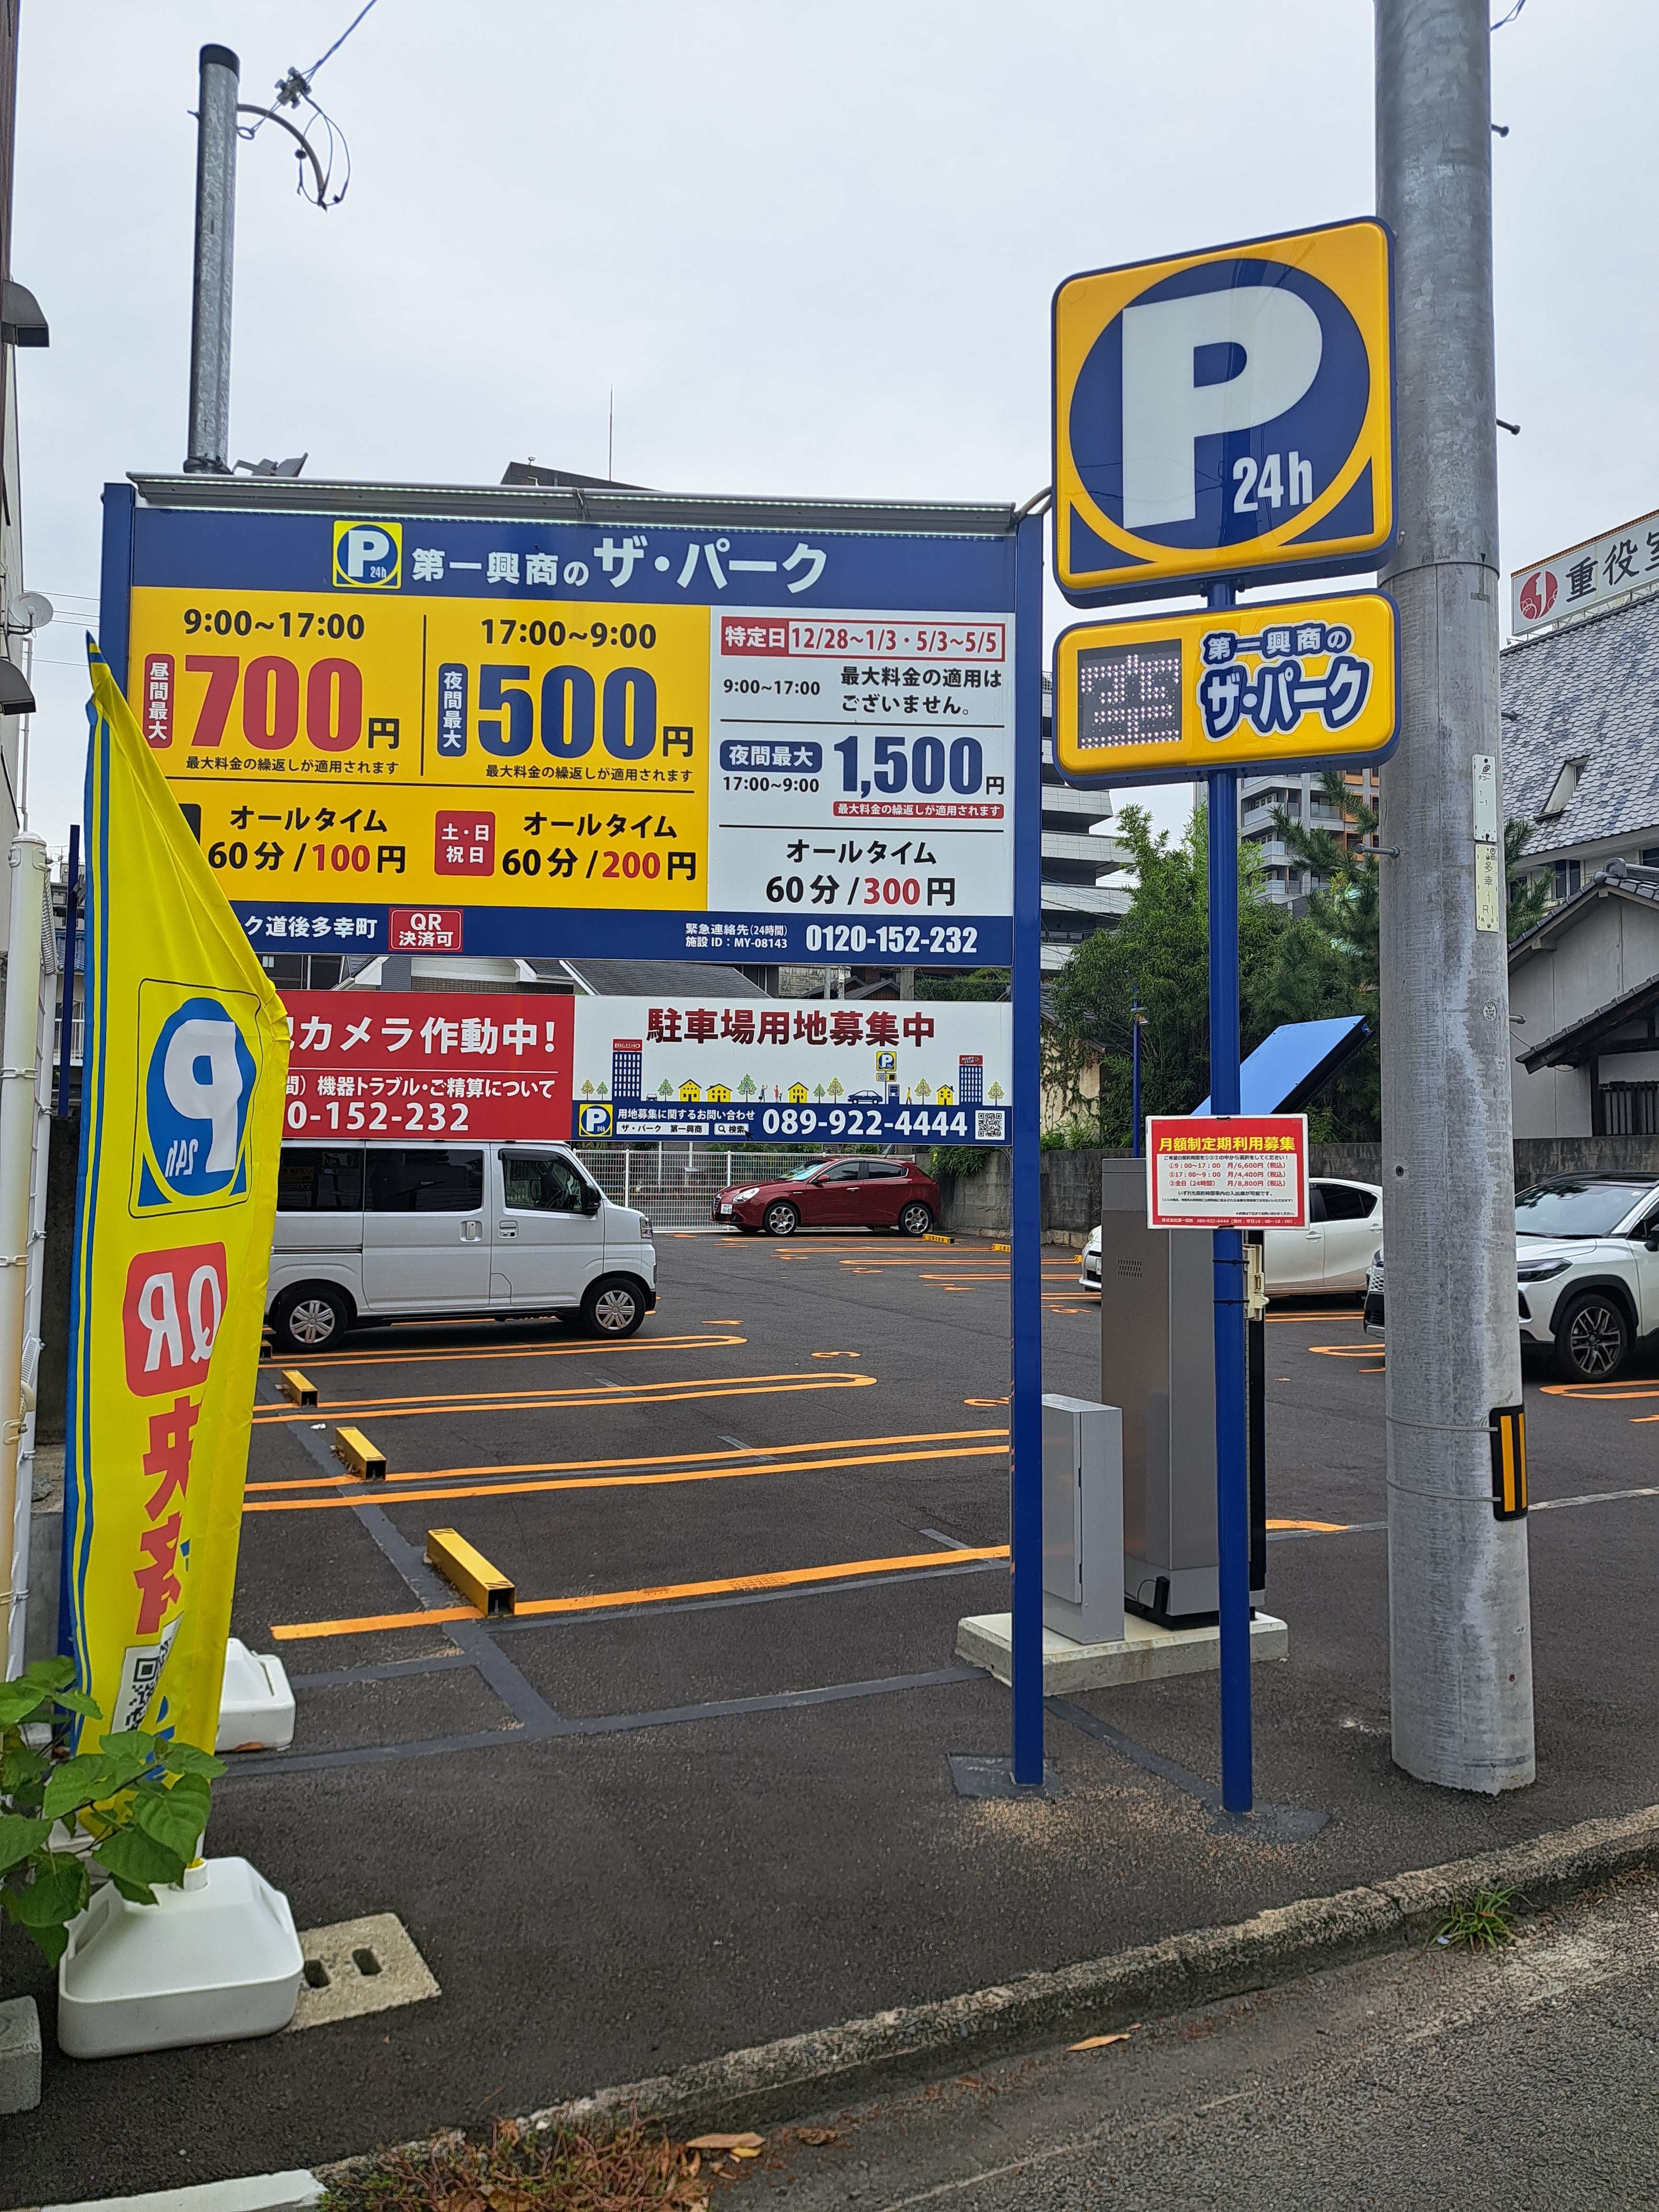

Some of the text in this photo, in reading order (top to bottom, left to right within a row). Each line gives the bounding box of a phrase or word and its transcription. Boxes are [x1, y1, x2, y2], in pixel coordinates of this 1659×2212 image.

[1122, 286, 1323, 530] P
[1233, 450, 1313, 514] 24h
[348, 530, 389, 577] P
[411, 535, 827, 594] 第一興商のザ・パーク
[370, 566, 387, 578] 24h
[725, 627, 785, 649] 特定日
[1208, 627, 1348, 661] 第一興商の
[841, 665, 1002, 689] 最大料金の適用は
[148, 662, 169, 741] 昼間最大
[841, 694, 969, 716] ございません。
[1207, 663, 1363, 732] ザ・パーク
[443, 671, 463, 749] 夜間最大
[186, 755, 399, 775] 最大料金の繰返しが適用されます
[729, 745, 814, 767] 夜間最大
[486, 764, 693, 783] 最大料金の繰返しが適用されます
[230, 805, 388, 833] オールタイム
[837, 803, 1000, 817] 最大料金の繰返しが適用されます
[442, 824, 489, 842] 土・日
[523, 811, 678, 839] オールタイム
[446, 846, 484, 864] 祝日
[787, 839, 937, 865] オールタイム
[239, 915, 378, 939] ク道後多幸町
[410, 913, 442, 931] QR
[398, 930, 453, 947] 決済可
[806, 924, 978, 953] 0120-152-232
[646, 1007, 935, 1047] 駐車場用地募集中
[318, 1076, 555, 1099] 機器トラブル・ご精算について
[586, 1108, 607, 1132] P
[618, 1108, 755, 1121] 用地募集に関するお問い合わせ
[763, 1109, 968, 1137] 089-922-4444
[621, 1124, 703, 1133] ザ・パーク 第一興商
[729, 1125, 745, 1134] 検索
[1159, 1136, 1296, 1151] 月額制定期利用募集
